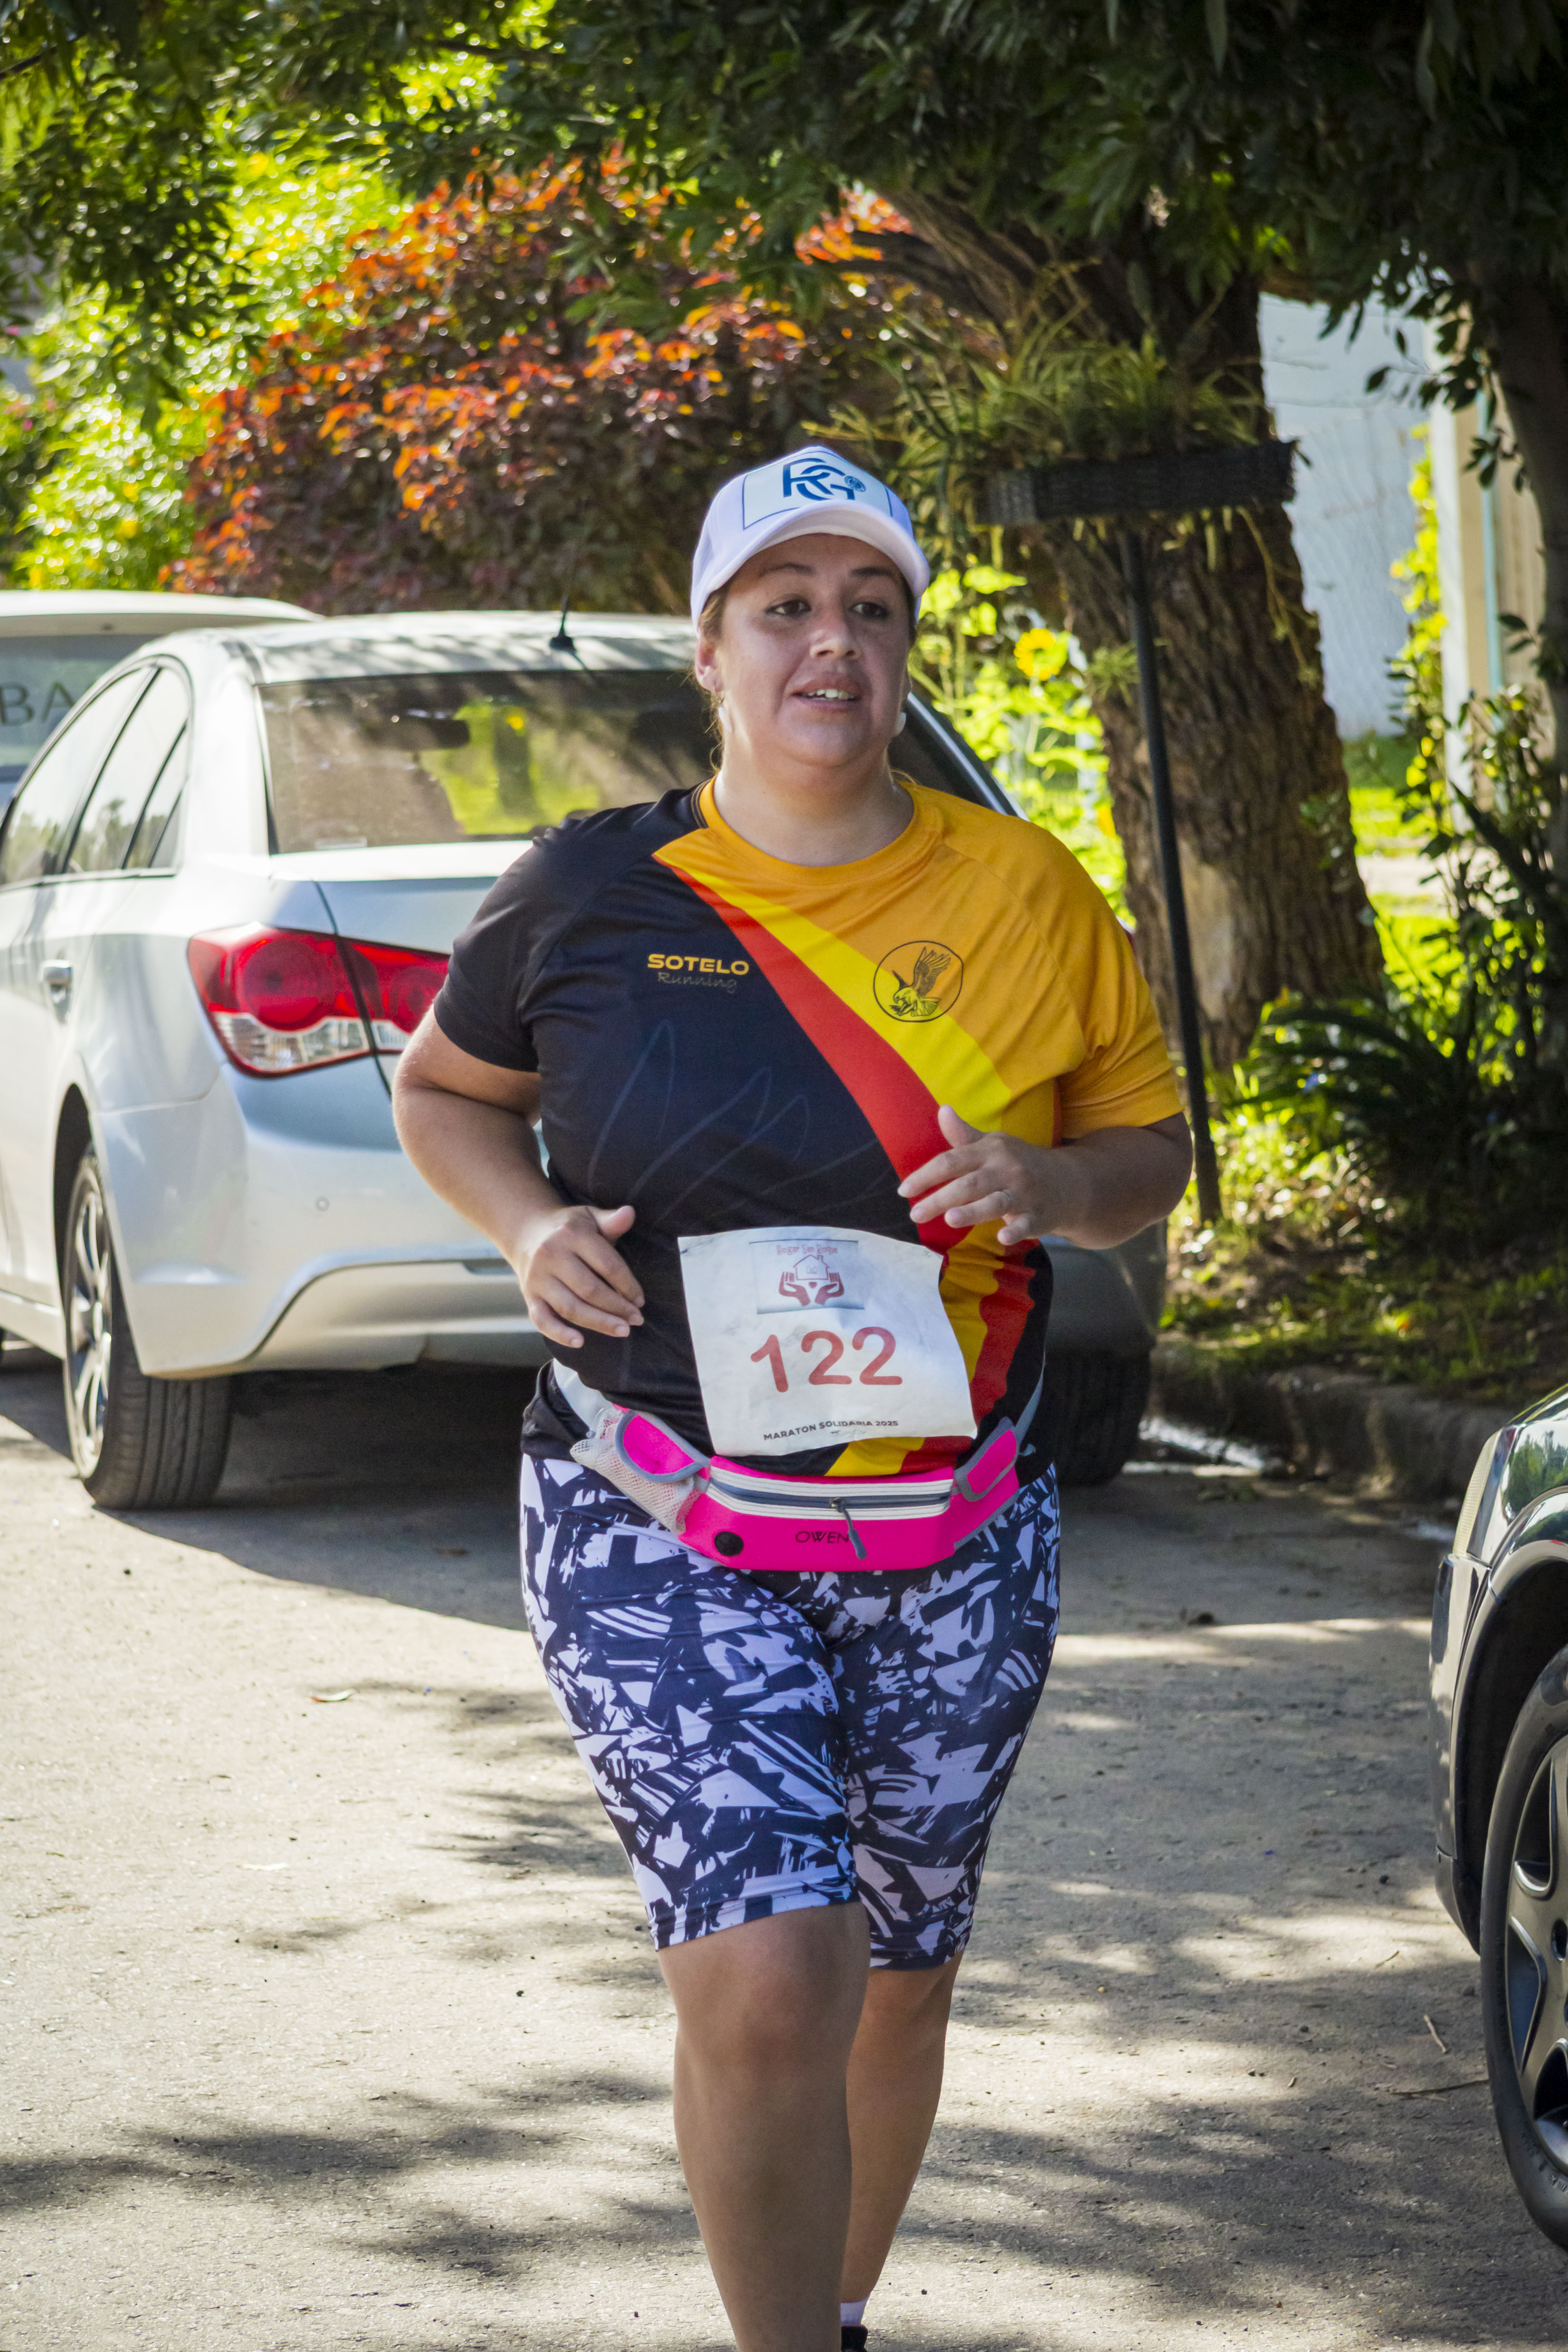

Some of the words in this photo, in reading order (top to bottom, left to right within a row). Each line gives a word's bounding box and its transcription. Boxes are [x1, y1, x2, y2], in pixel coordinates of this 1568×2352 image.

[647, 953, 749, 975] SOTELO
[657, 972, 737, 994] Running
[751, 1326, 903, 1393] 122
[763, 1424, 817, 1440] MARATON
[819, 1420, 872, 1429] SOLIDARIA
[796, 1531, 849, 1543] OWEN
